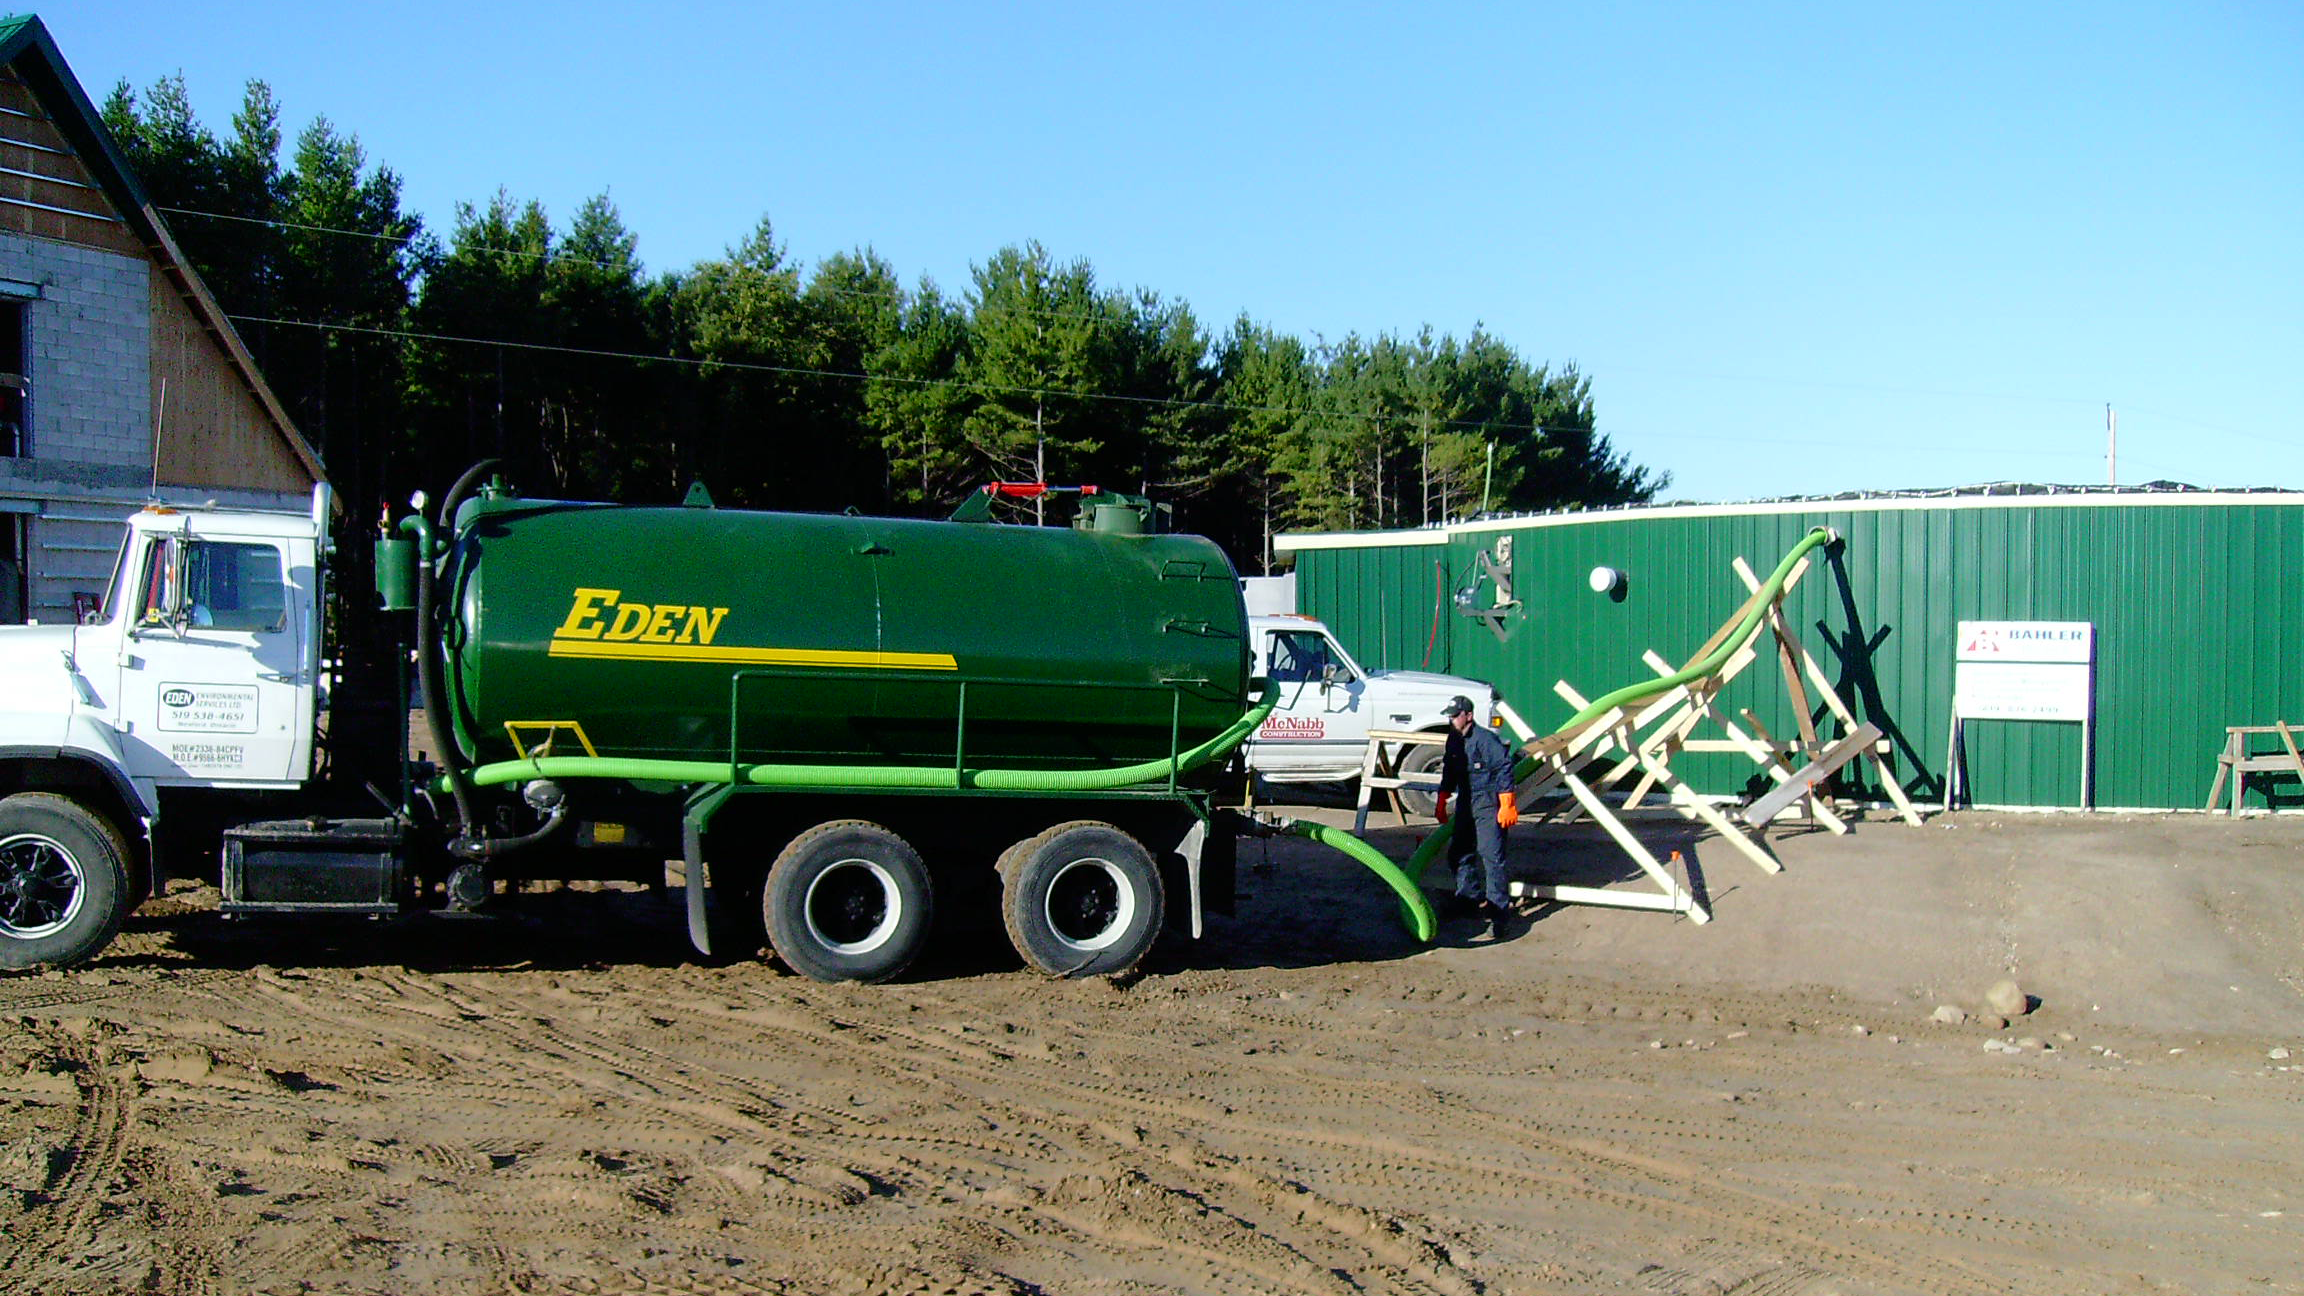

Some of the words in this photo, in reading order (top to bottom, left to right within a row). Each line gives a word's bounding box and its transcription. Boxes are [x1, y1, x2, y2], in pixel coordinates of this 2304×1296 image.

[554, 587, 730, 645] EDEN
[2009, 629, 2083, 641] BAHLER
[166, 692, 192, 704] EDEN
[196, 692, 254, 701] ENVIRONMENTAL
[172, 711, 190, 719] 519
[1262, 717, 1325, 729] McNabb
